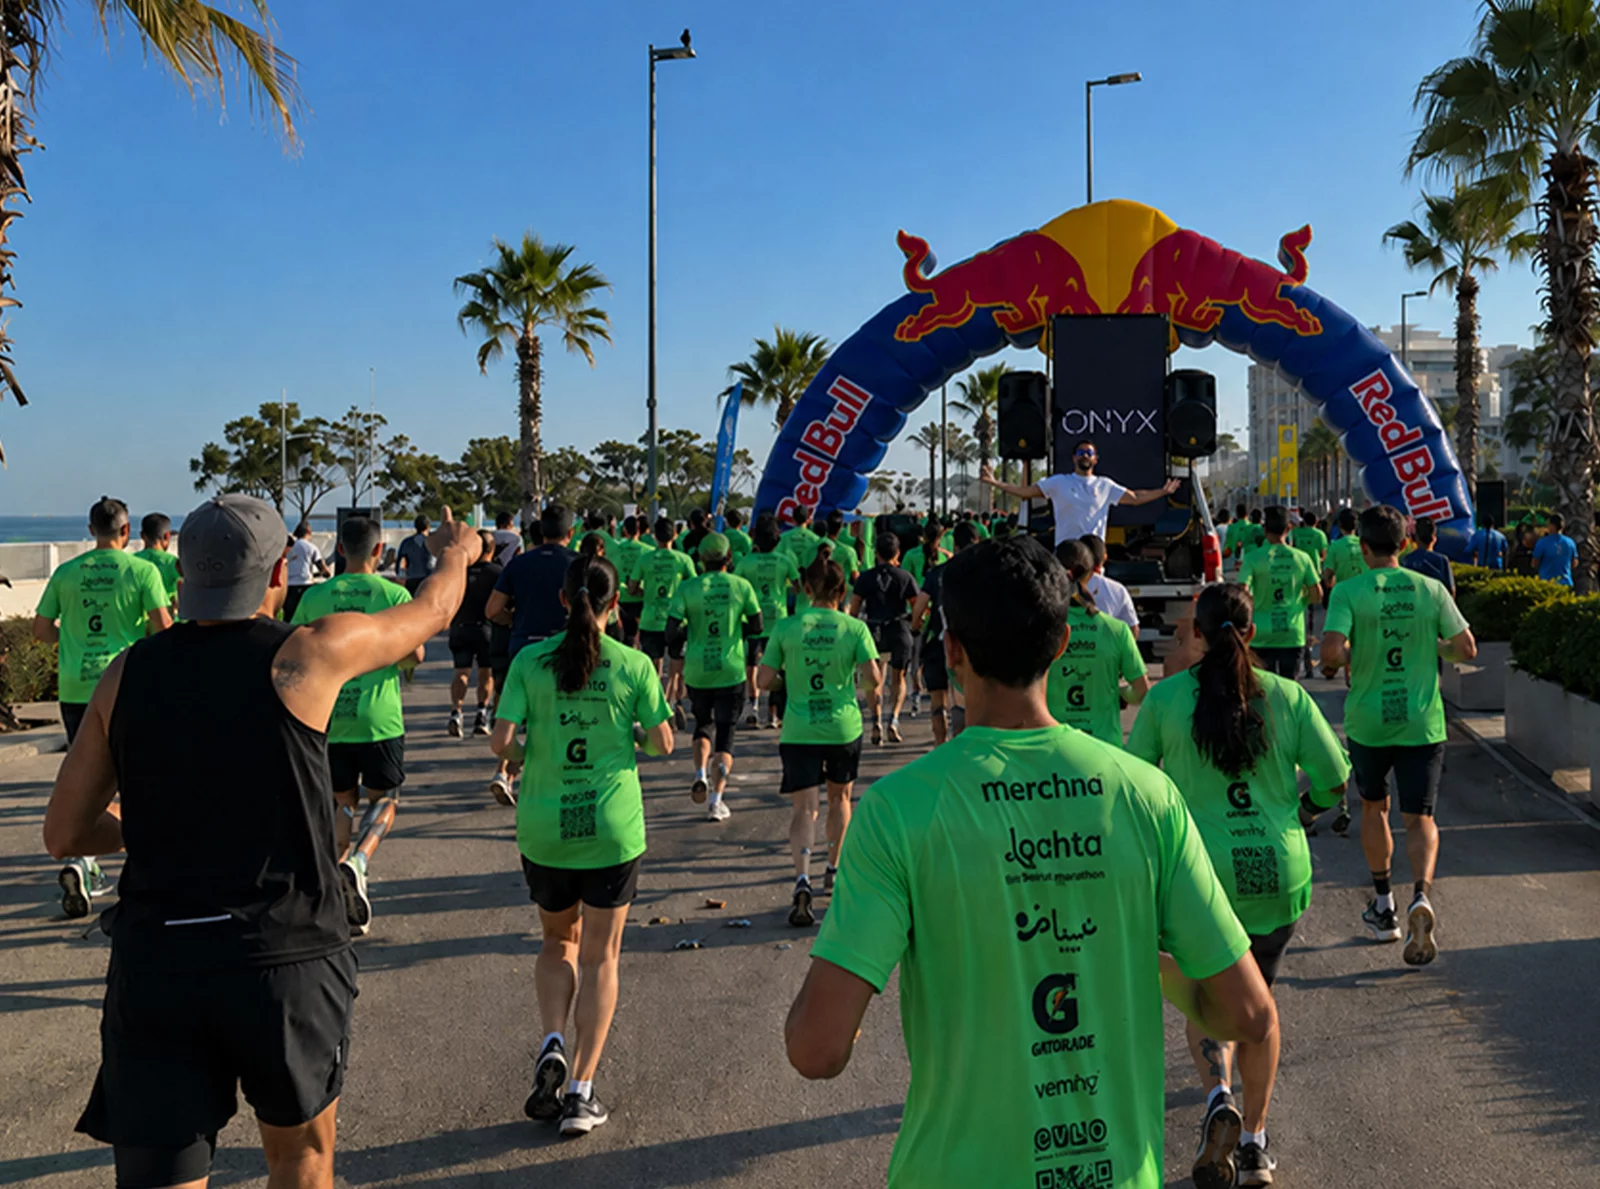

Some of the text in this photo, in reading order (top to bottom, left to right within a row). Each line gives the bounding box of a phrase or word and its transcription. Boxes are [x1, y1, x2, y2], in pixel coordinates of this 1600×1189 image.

[800, 374, 873, 460] Bull
[1062, 409, 1157, 434] ONYX
[1348, 368, 1424, 454] Red
[1387, 647, 1402, 667] G
[1067, 685, 1085, 706] G
[566, 737, 587, 763] G
[981, 772, 1104, 802] merchna
[1226, 781, 1252, 809] G
[1032, 972, 1079, 1034] G
[1031, 1034, 1095, 1057] GATORADE
